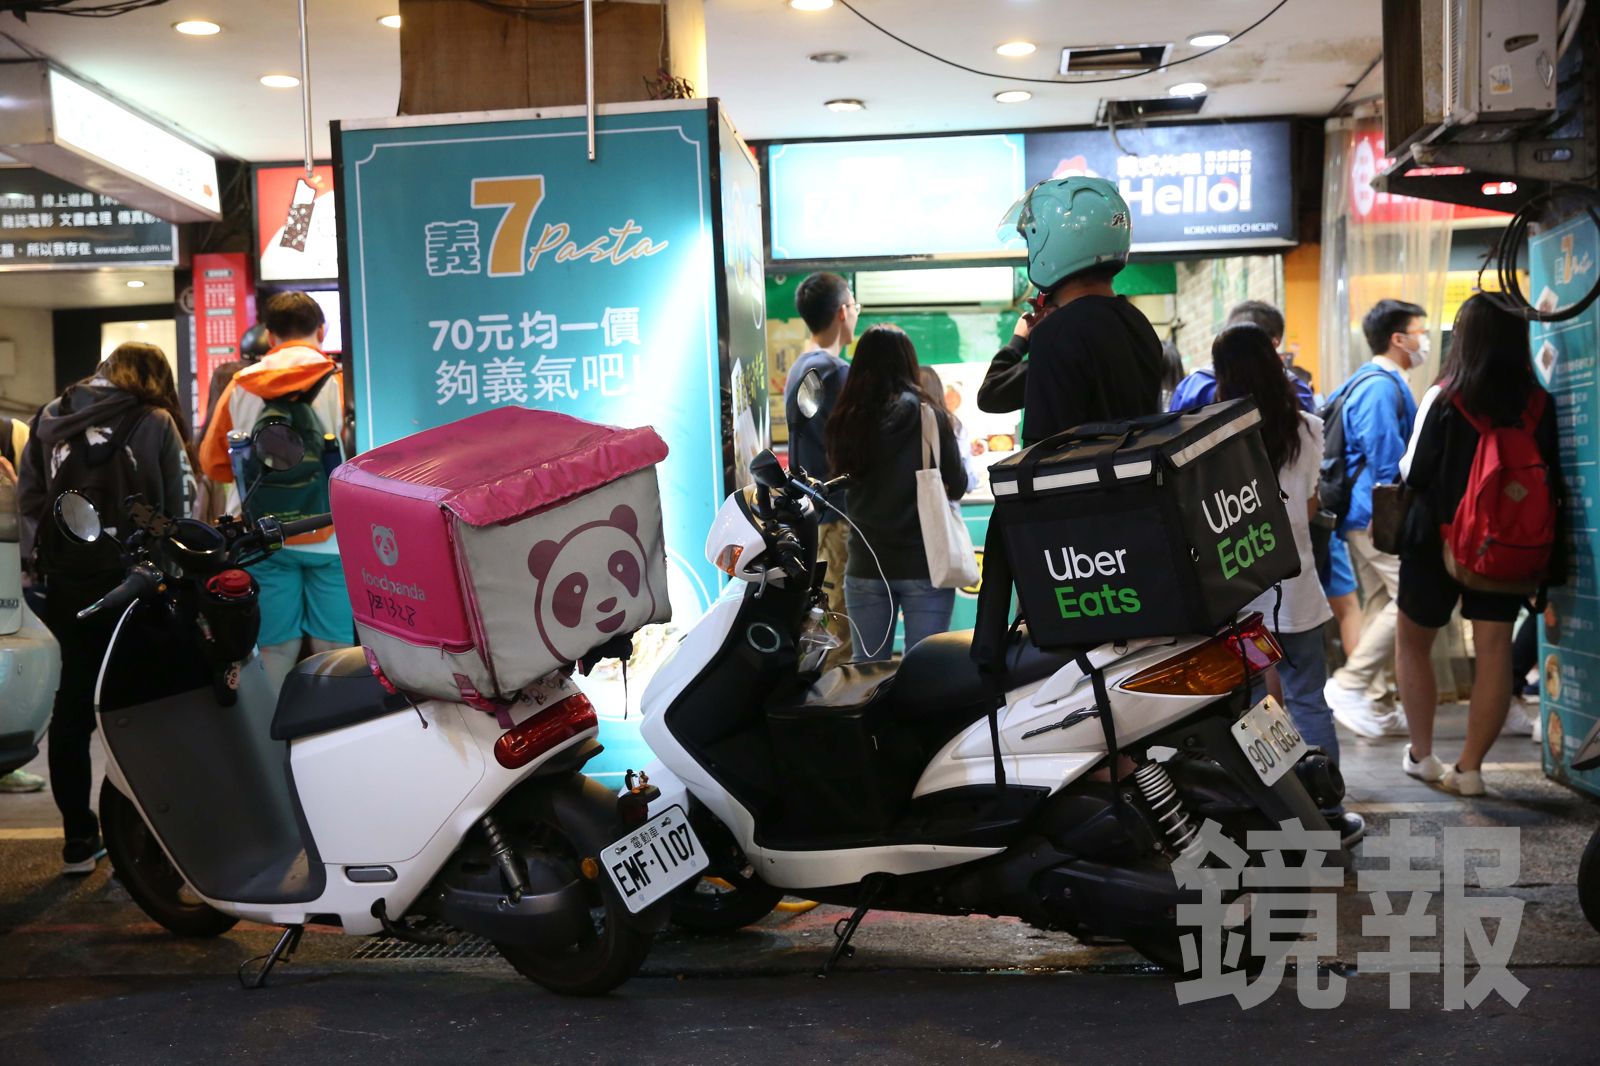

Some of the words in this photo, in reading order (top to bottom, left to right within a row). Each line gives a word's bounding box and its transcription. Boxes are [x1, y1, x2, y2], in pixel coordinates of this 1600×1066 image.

[1119, 174, 1252, 216] Hello!
[527, 219, 668, 271] Pasta
[428, 307, 640, 352] 70元均一價
[1202, 479, 1263, 534] Uber
[1044, 547, 1127, 581] Uber
[1217, 521, 1276, 580] Eats
[361, 568, 426, 601] foodpanda
[1055, 583, 1141, 619] Eats
[612, 823, 695, 897] EMF-1107
